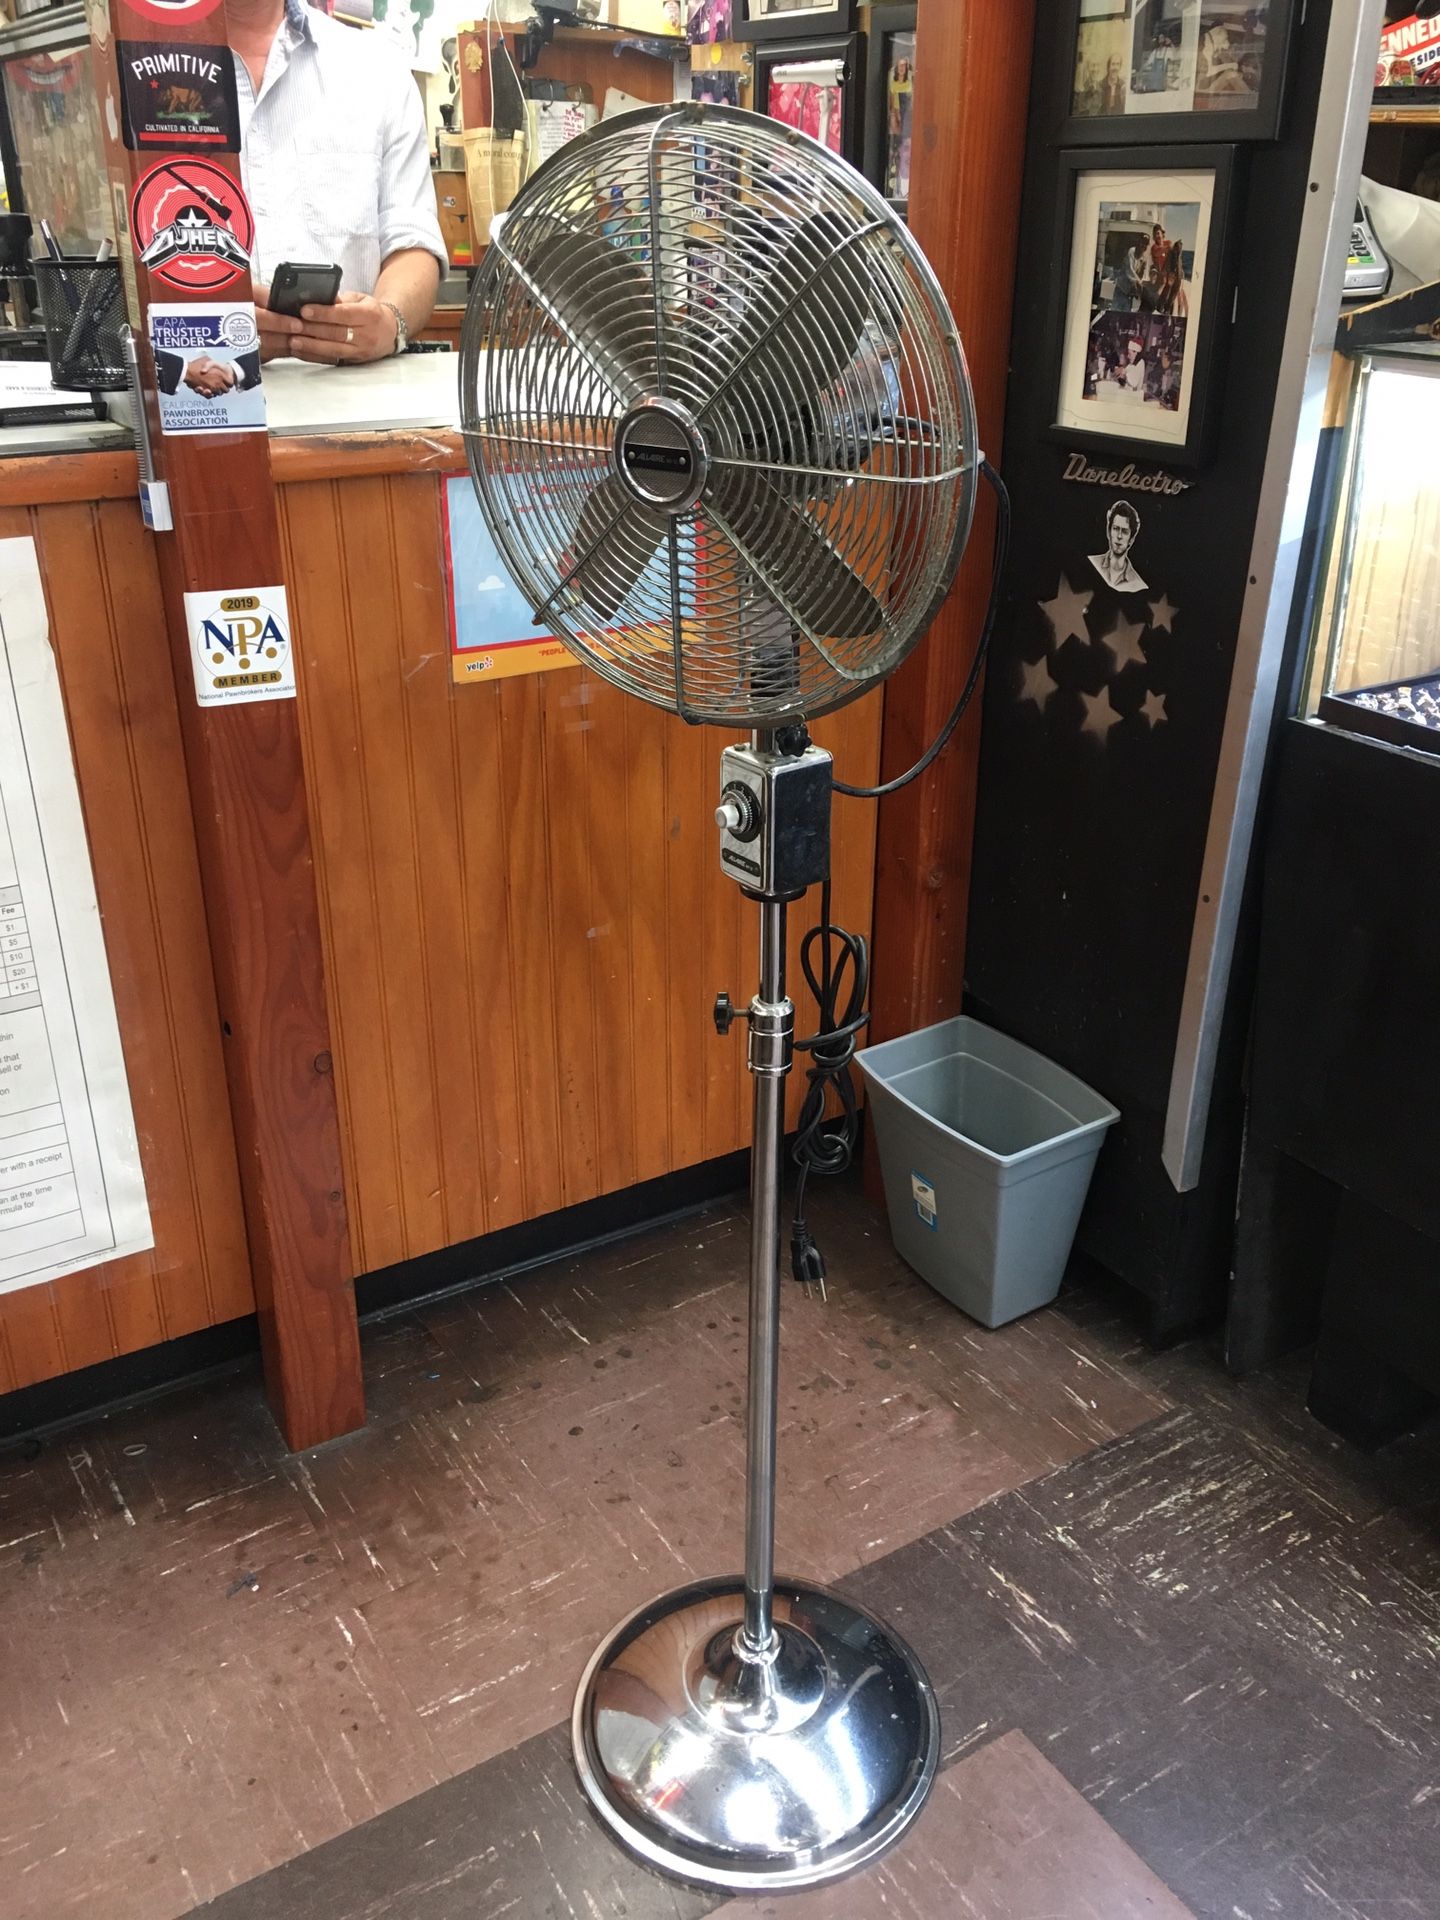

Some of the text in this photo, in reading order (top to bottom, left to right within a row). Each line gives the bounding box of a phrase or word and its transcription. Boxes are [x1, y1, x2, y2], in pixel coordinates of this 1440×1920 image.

[131, 53, 222, 84] PRIMITIVE
[145, 123, 178, 132] CULTIVATED
[188, 125, 220, 133] CALIFORNIA
[154, 317, 187, 327] CAPA
[155, 327, 211, 337] TRUSTED
[157, 337, 206, 347] LENDER
[232, 334, 251, 342] 2017
[162, 400, 214, 409] CALIFORNIA
[163, 408, 228, 418] PAWNBROKER
[165, 417, 229, 426] ASSOCIATION
[227, 598, 253, 609] 2019
[200, 614, 285, 657] NPA
[466, 661, 485, 672] yelp
[218, 673, 278, 687] MEMBER
[199, 692, 223, 700] National
[1, 907, 15, 915] Fee
[5, 924, 15, 932] $1
[9, 953, 23, 961] $10
[12, 968, 26, 976] $20
[4, 1052, 20, 1062] that
[13, 1063, 22, 1071] or
[10, 1161, 26, 1171] with
[35, 1152, 63, 1165] receipt
[20, 1190, 33, 1199] the
[35, 1185, 52, 1195] time
[24, 1200, 34, 1209] for
